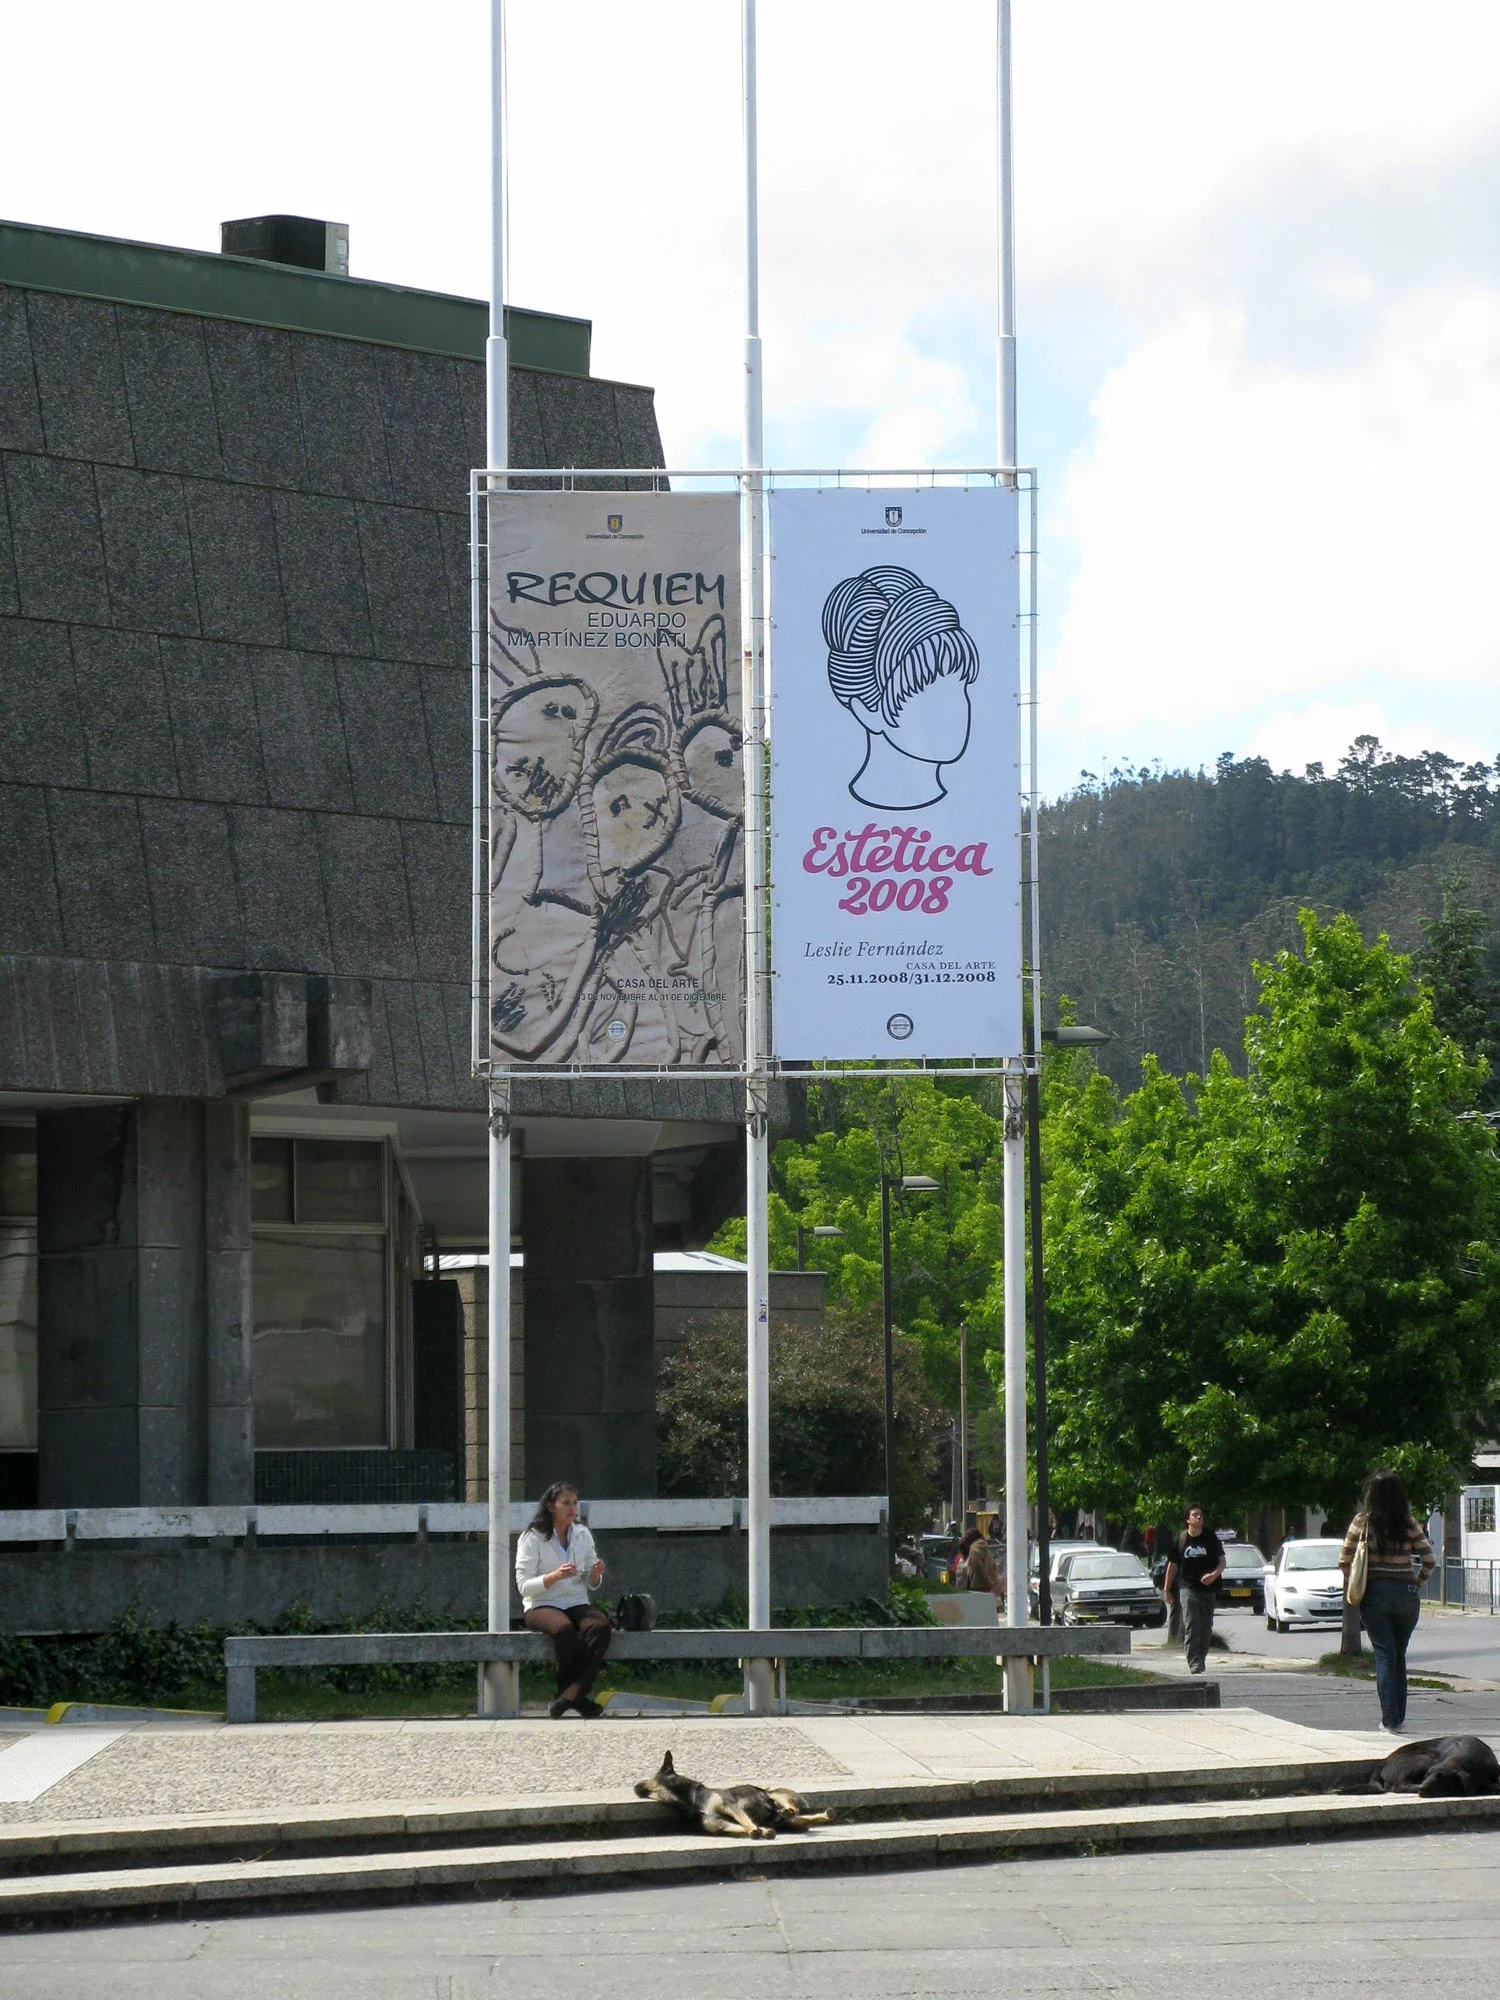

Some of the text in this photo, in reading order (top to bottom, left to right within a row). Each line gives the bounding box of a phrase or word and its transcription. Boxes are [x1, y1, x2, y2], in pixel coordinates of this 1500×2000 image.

[506, 571, 726, 610] REQUIEM
[587, 612, 687, 628] EDUARDO
[507, 628, 687, 648] MARTÍNEZ BONATI
[838, 876, 954, 916] 2008
[804, 941, 944, 958] Leslie Fernández
[906, 962, 996, 970] CASA DEL ARTE
[617, 978, 699, 988] CASA DEL ARTE
[827, 972, 996, 986] 25.11.2008/31.12.2008
